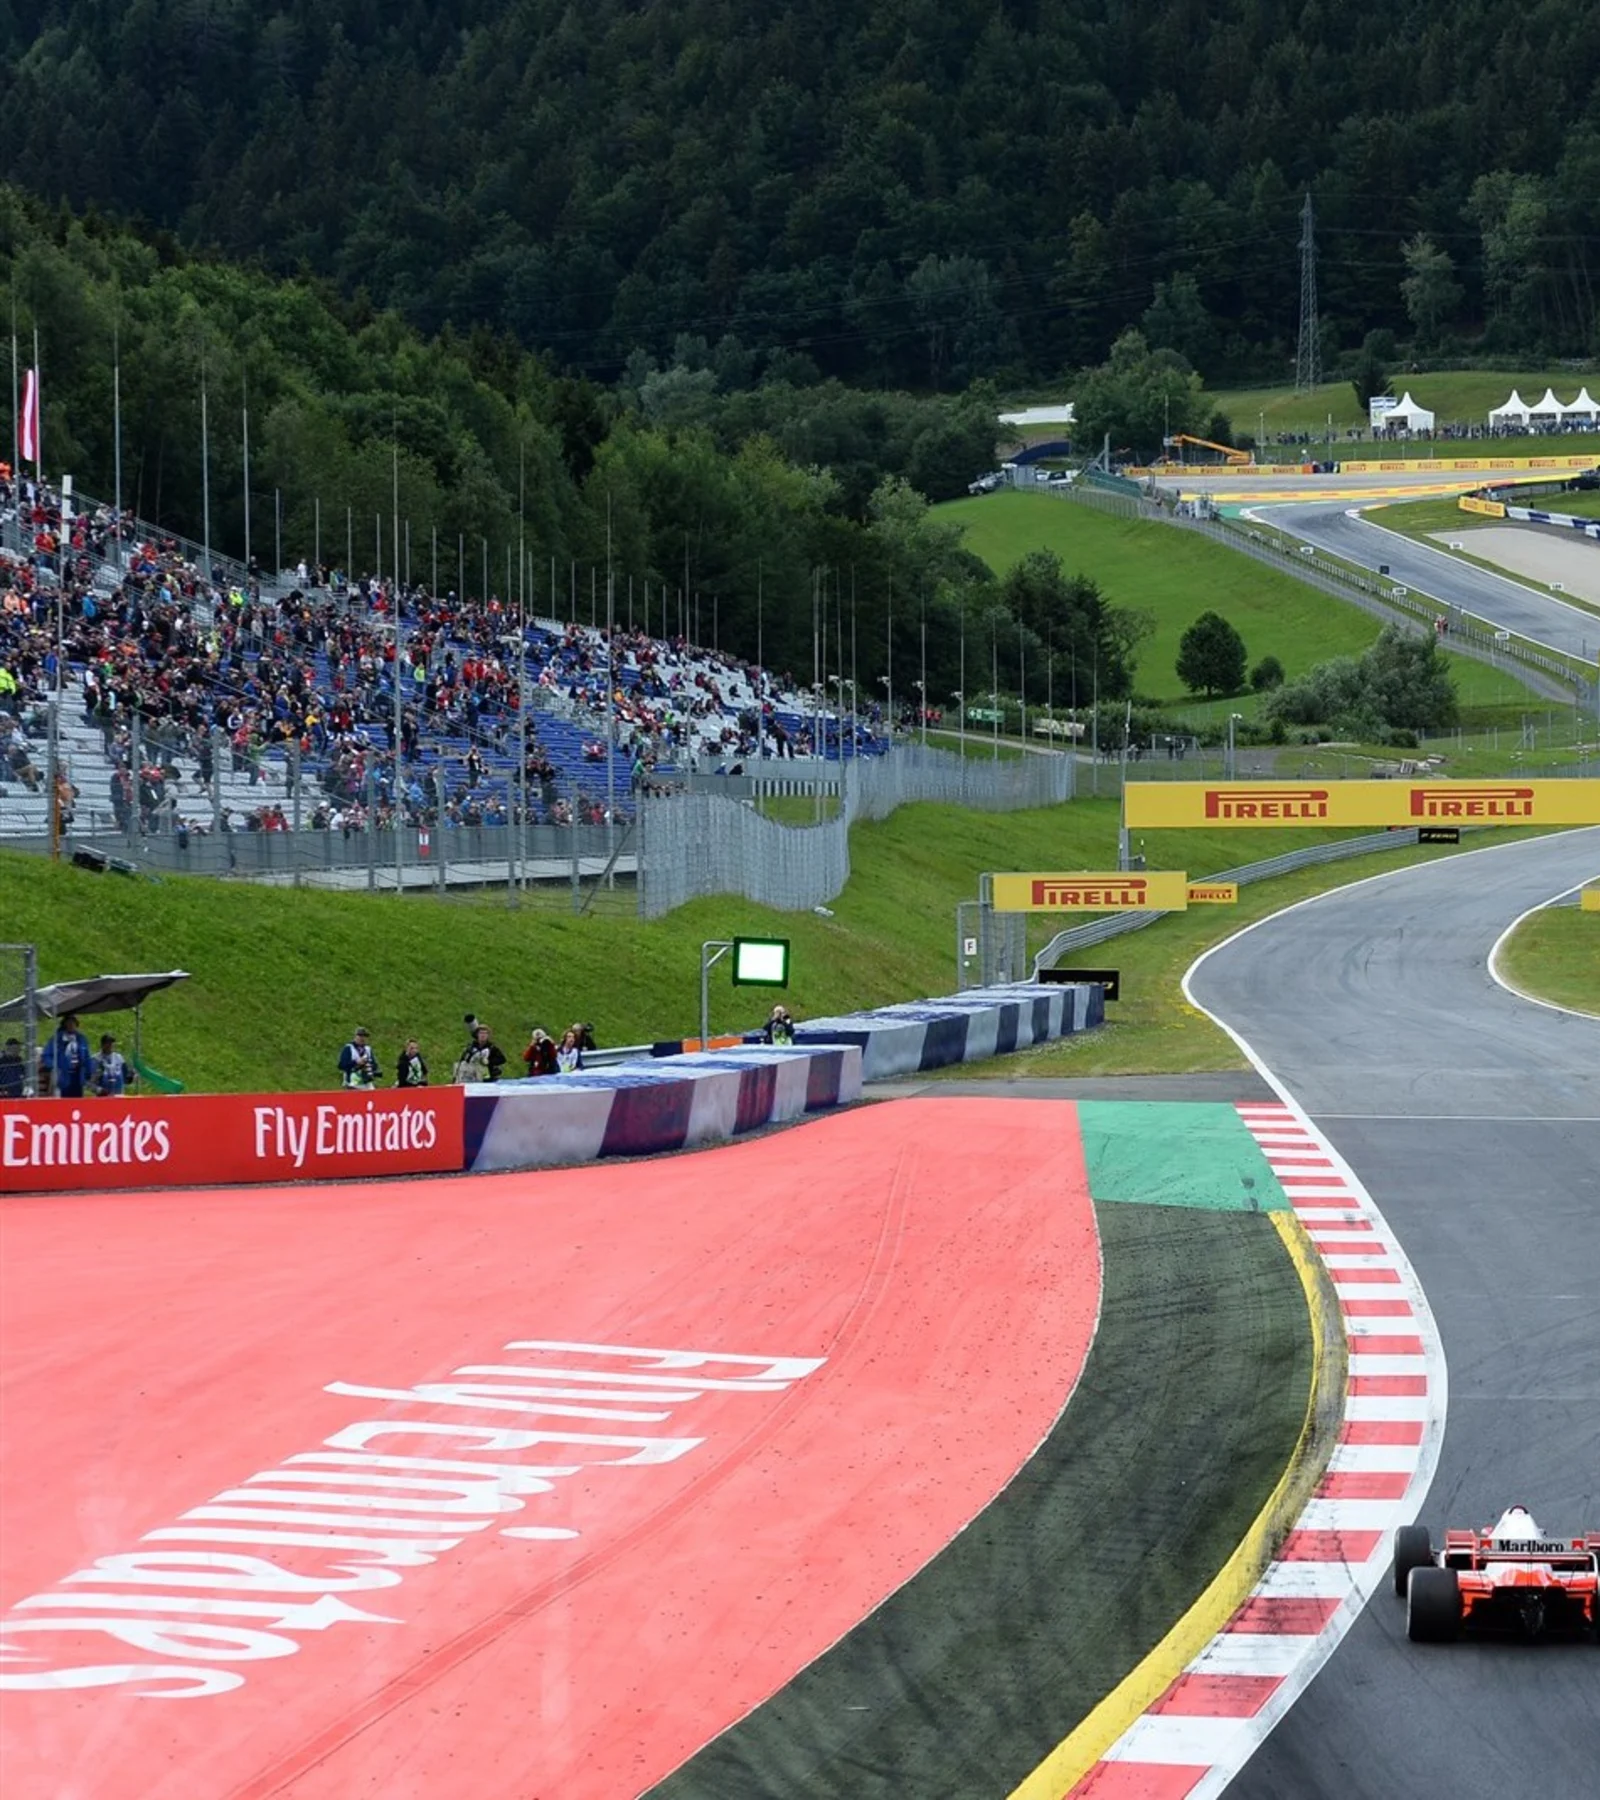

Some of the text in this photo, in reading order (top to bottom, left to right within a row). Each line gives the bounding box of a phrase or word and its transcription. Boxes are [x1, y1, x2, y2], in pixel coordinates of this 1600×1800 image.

[1205, 791, 1328, 818] PIRELLI
[1411, 789, 1534, 816] PIRELLI
[1032, 880, 1147, 905] PIRELLI
[1190, 888, 1232, 900] PIRELLI
[2, 1110, 170, 1167] Emirates
[254, 1101, 436, 1168] Fly Emirates
[1499, 1539, 1565, 1553] Marlboro
